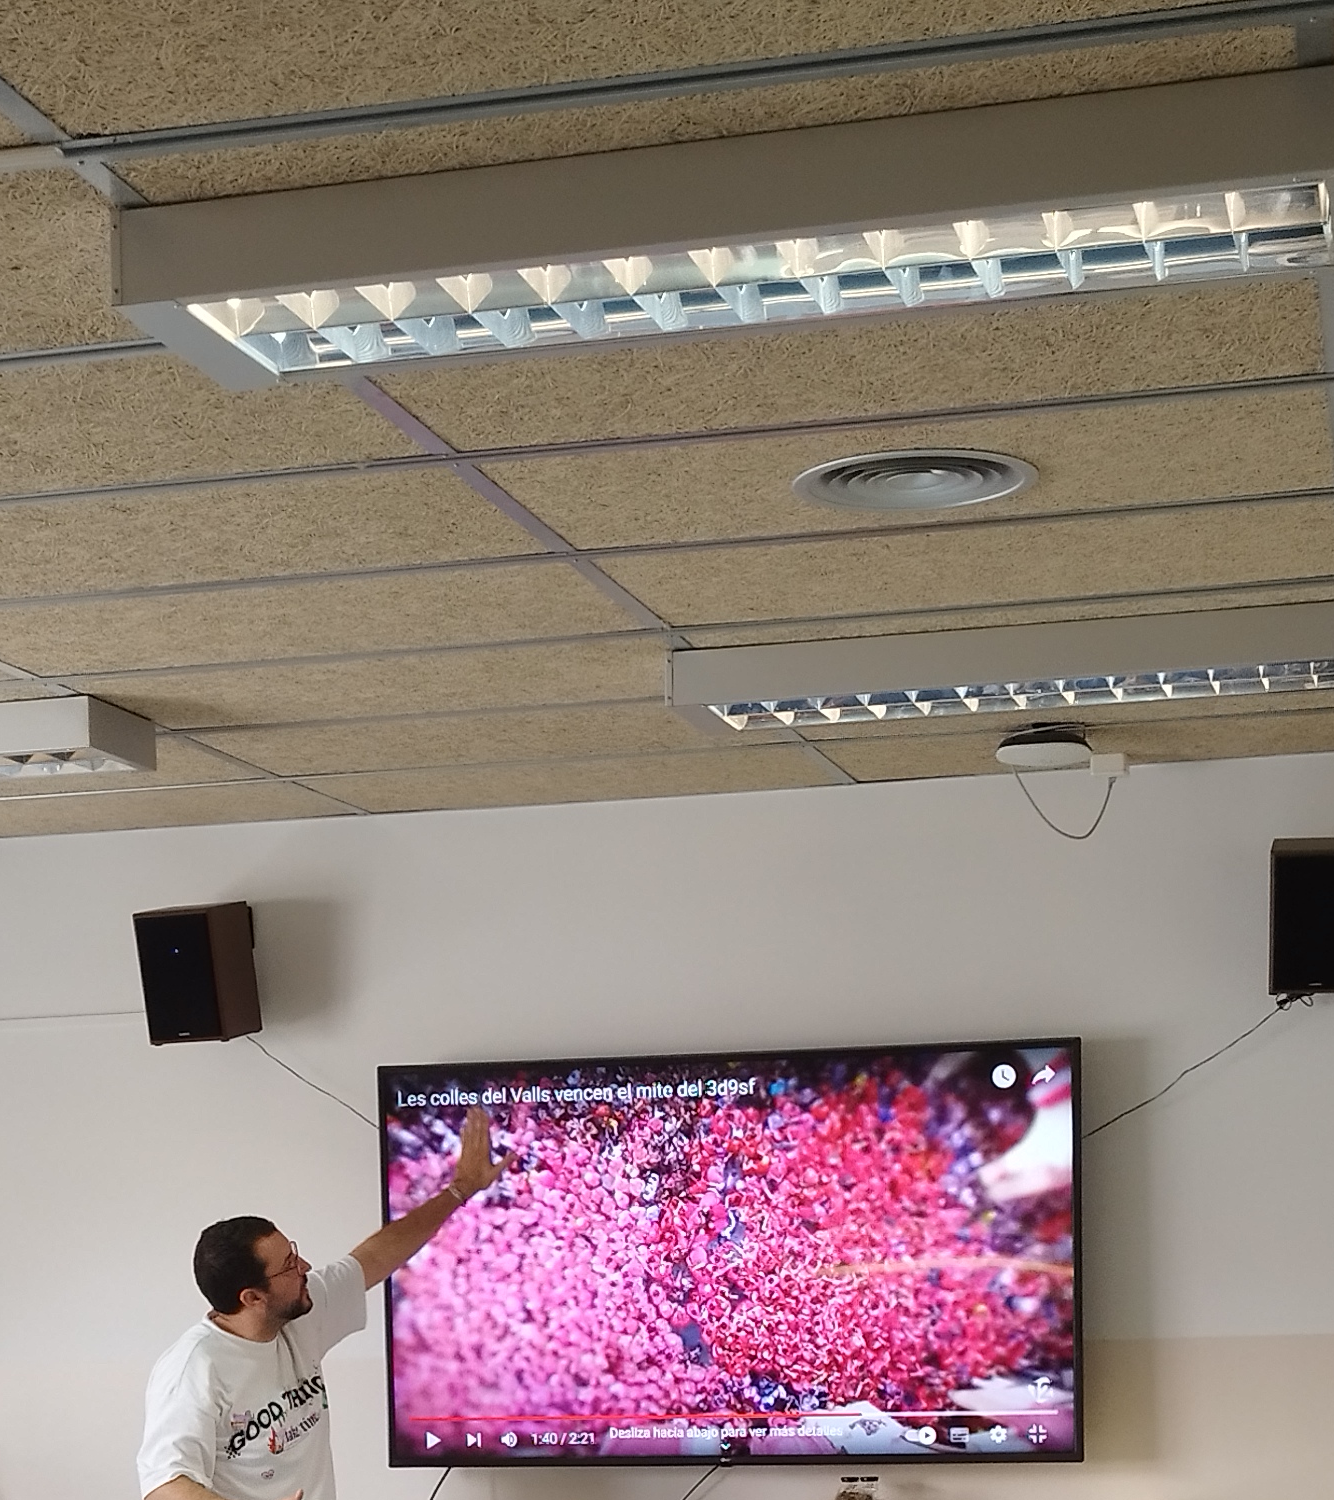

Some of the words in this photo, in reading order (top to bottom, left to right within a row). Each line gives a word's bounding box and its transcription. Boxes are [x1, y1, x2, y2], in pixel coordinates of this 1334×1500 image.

[397, 1090, 427, 1107] Les
[430, 1087, 478, 1106] colles
[481, 1086, 506, 1105] del
[510, 1086, 551, 1103] Valls
[554, 1086, 612, 1103] vencen
[617, 1083, 632, 1100] el
[677, 1079, 702, 1098] del
[705, 1077, 757, 1097] 3d9sf
[229, 1402, 283, 1451] GOOD
[609, 1427, 651, 1439] Desliza
[653, 1427, 684, 1439] hacia
[686, 1426, 719, 1440] abajo
[720, 1427, 747, 1439] para
[748, 1427, 767, 1438] ver
[769, 1425, 797, 1437] más
[797, 1425, 843, 1437] detalles
[531, 1432, 558, 1445] 1:40
[560, 1432, 567, 1445] /
[568, 1432, 595, 1445] 2:21
